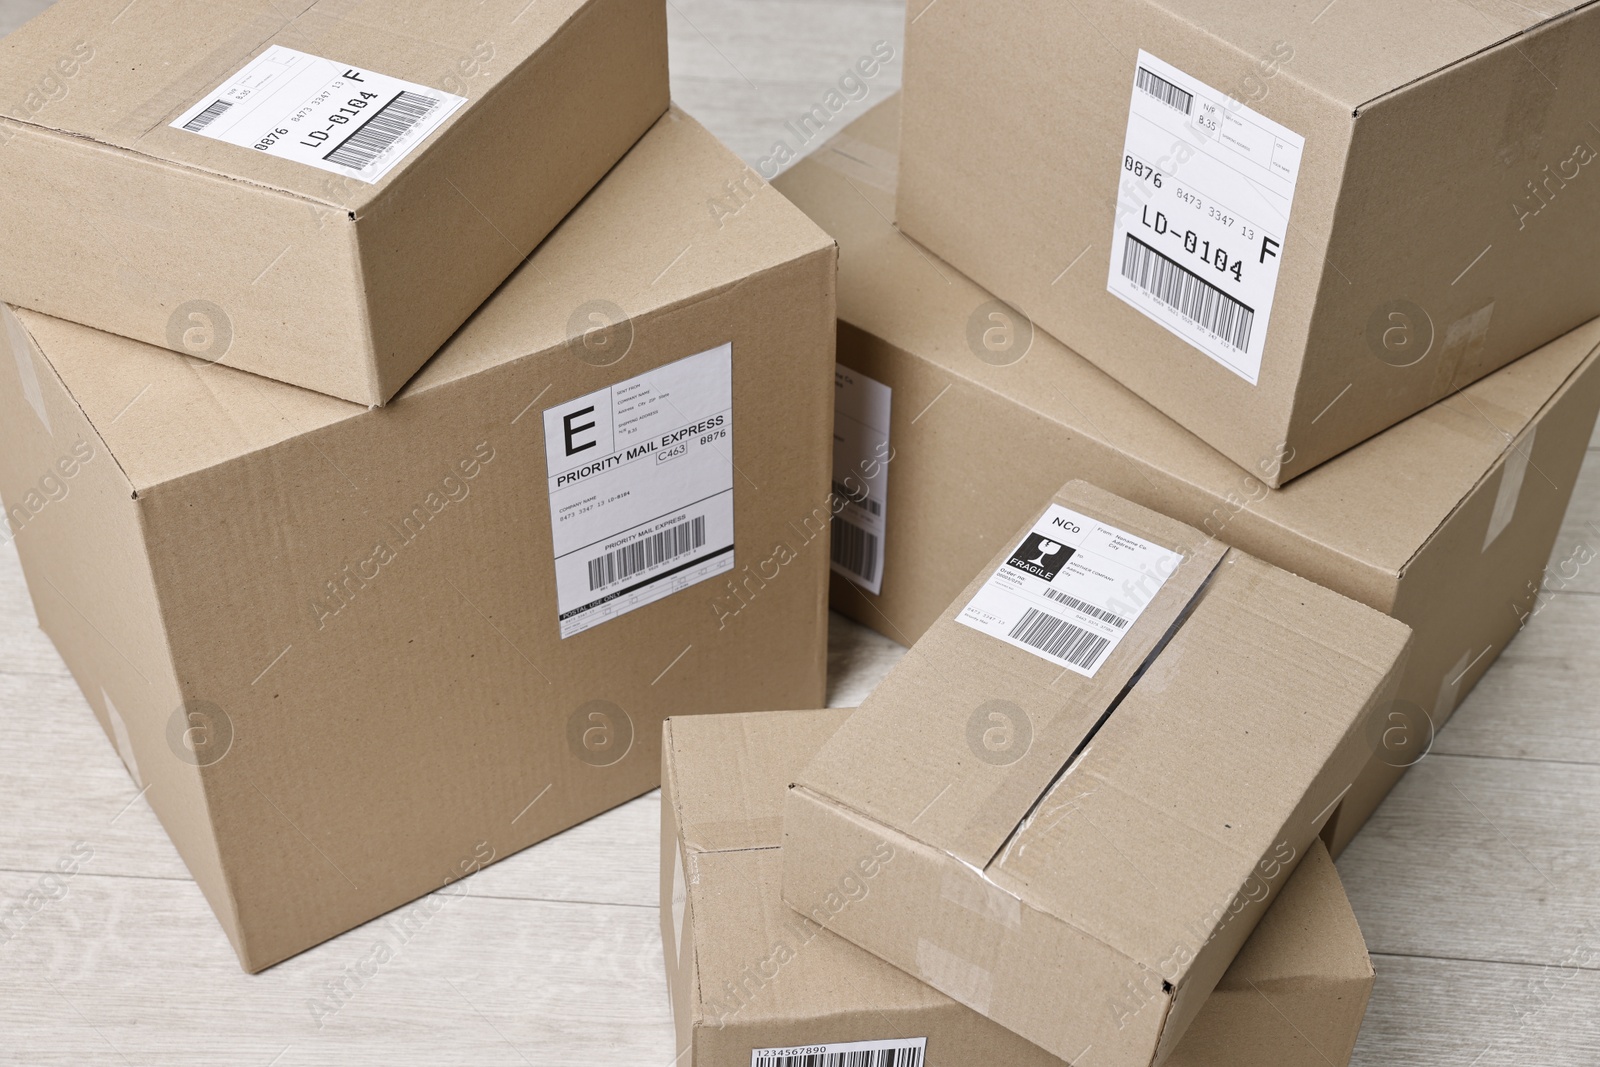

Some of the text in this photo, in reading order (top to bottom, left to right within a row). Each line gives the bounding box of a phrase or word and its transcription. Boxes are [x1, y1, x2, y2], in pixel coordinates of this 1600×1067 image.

[342, 69, 366, 84] F
[254, 127, 289, 151] 0876
[291, 107, 313, 123] 8473
[311, 90, 331, 107] 3347
[300, 90, 379, 149] LD-0104
[1198, 115, 1217, 132] 8.35
[1124, 155, 1255, 241] 0876 8473 3347 13
[1141, 204, 1244, 284] LD-0104
[1259, 235, 1281, 265] F
[563, 405, 597, 457] E
[556, 414, 725, 488] PRIORITY MAIL EXPRESS
[657, 428, 727, 461] C463 0876
[559, 495, 597, 513] COMPANY NAME
[578, 504, 594, 515] 3347
[604, 514, 687, 551] PRIORITY MAIL EXPRESS
[1111, 539, 1135, 551] Address
[1108, 542, 1120, 551] City
[999, 567, 1017, 577] Order
[1009, 557, 1054, 580] FRAGILE
[1069, 561, 1115, 582] ANOTHER COMPANY
[563, 606, 586, 619] POSTAL
[603, 591, 621, 602] ONLY
[756, 1046, 827, 1057] 1234567890
